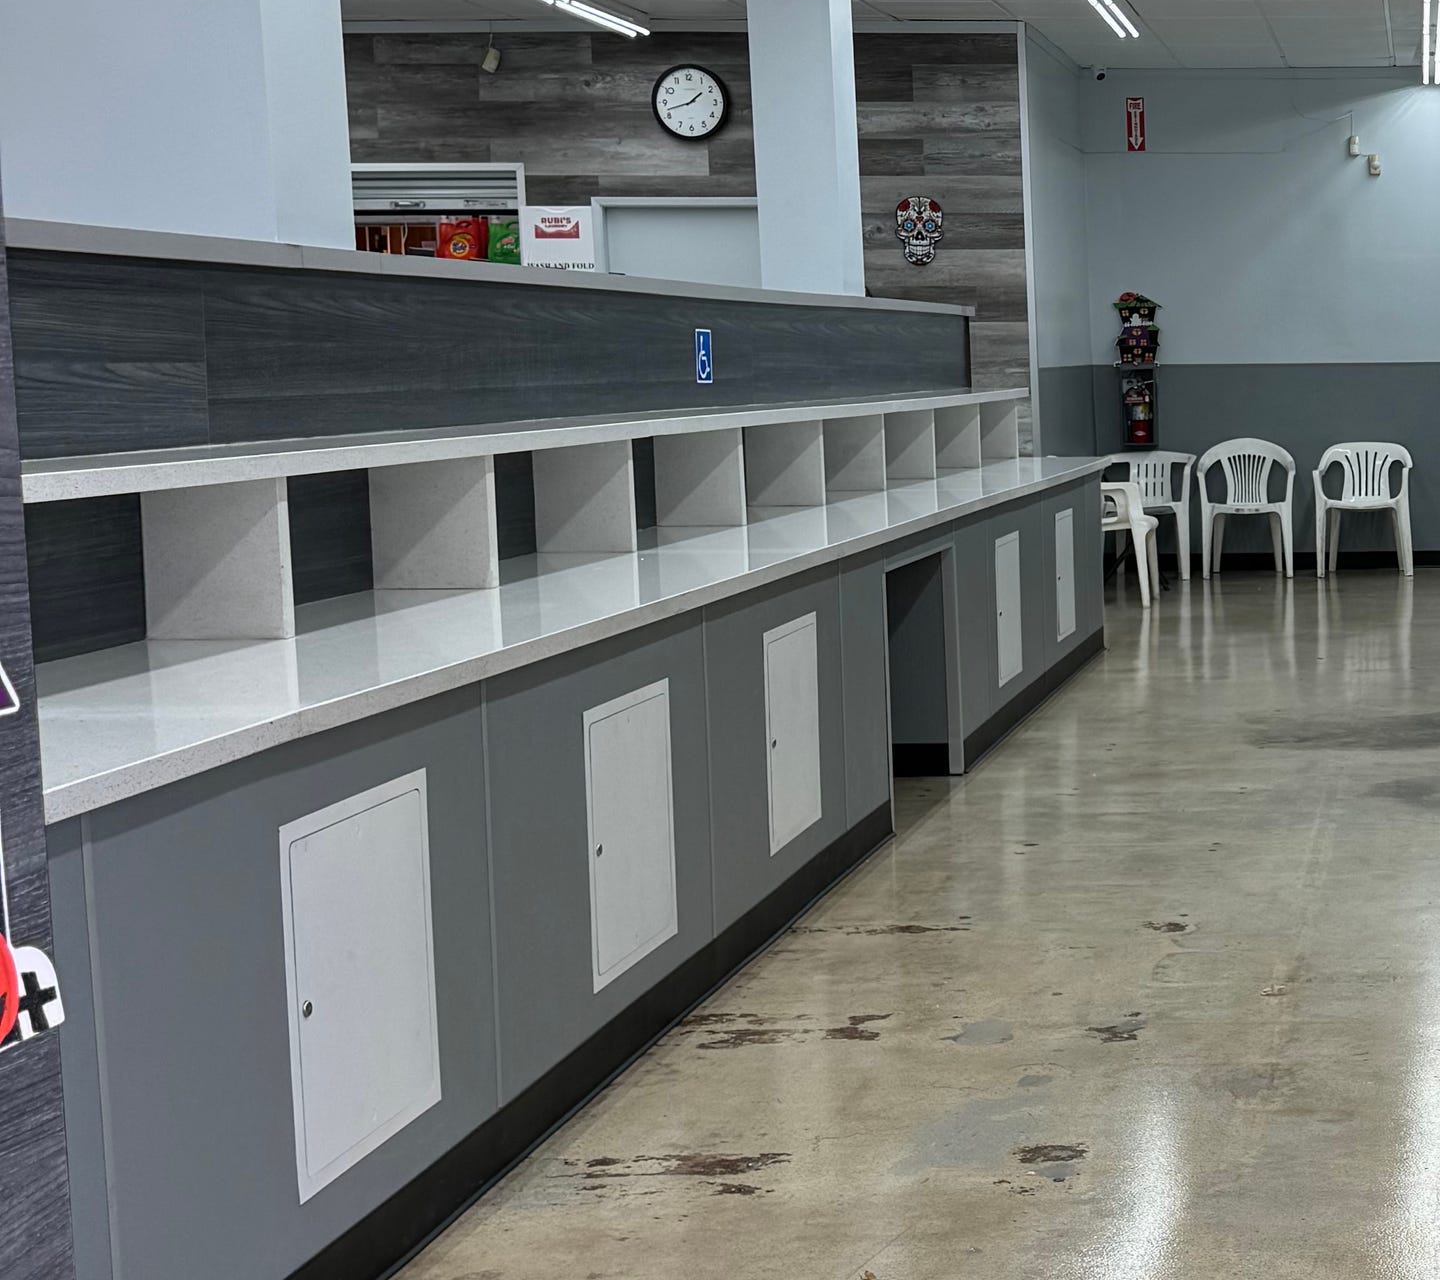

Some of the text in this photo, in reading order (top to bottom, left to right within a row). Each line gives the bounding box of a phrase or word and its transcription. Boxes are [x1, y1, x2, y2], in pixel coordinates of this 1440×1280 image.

[674, 77, 680, 85] 11
[685, 73, 692, 81] 12
[700, 77, 703, 85] 1
[665, 87, 675, 95] 10
[708, 85, 713, 93] 2
[678, 120, 683, 128] 7
[701, 120, 707, 128] 5
[571, 262, 595, 270] FOLD
